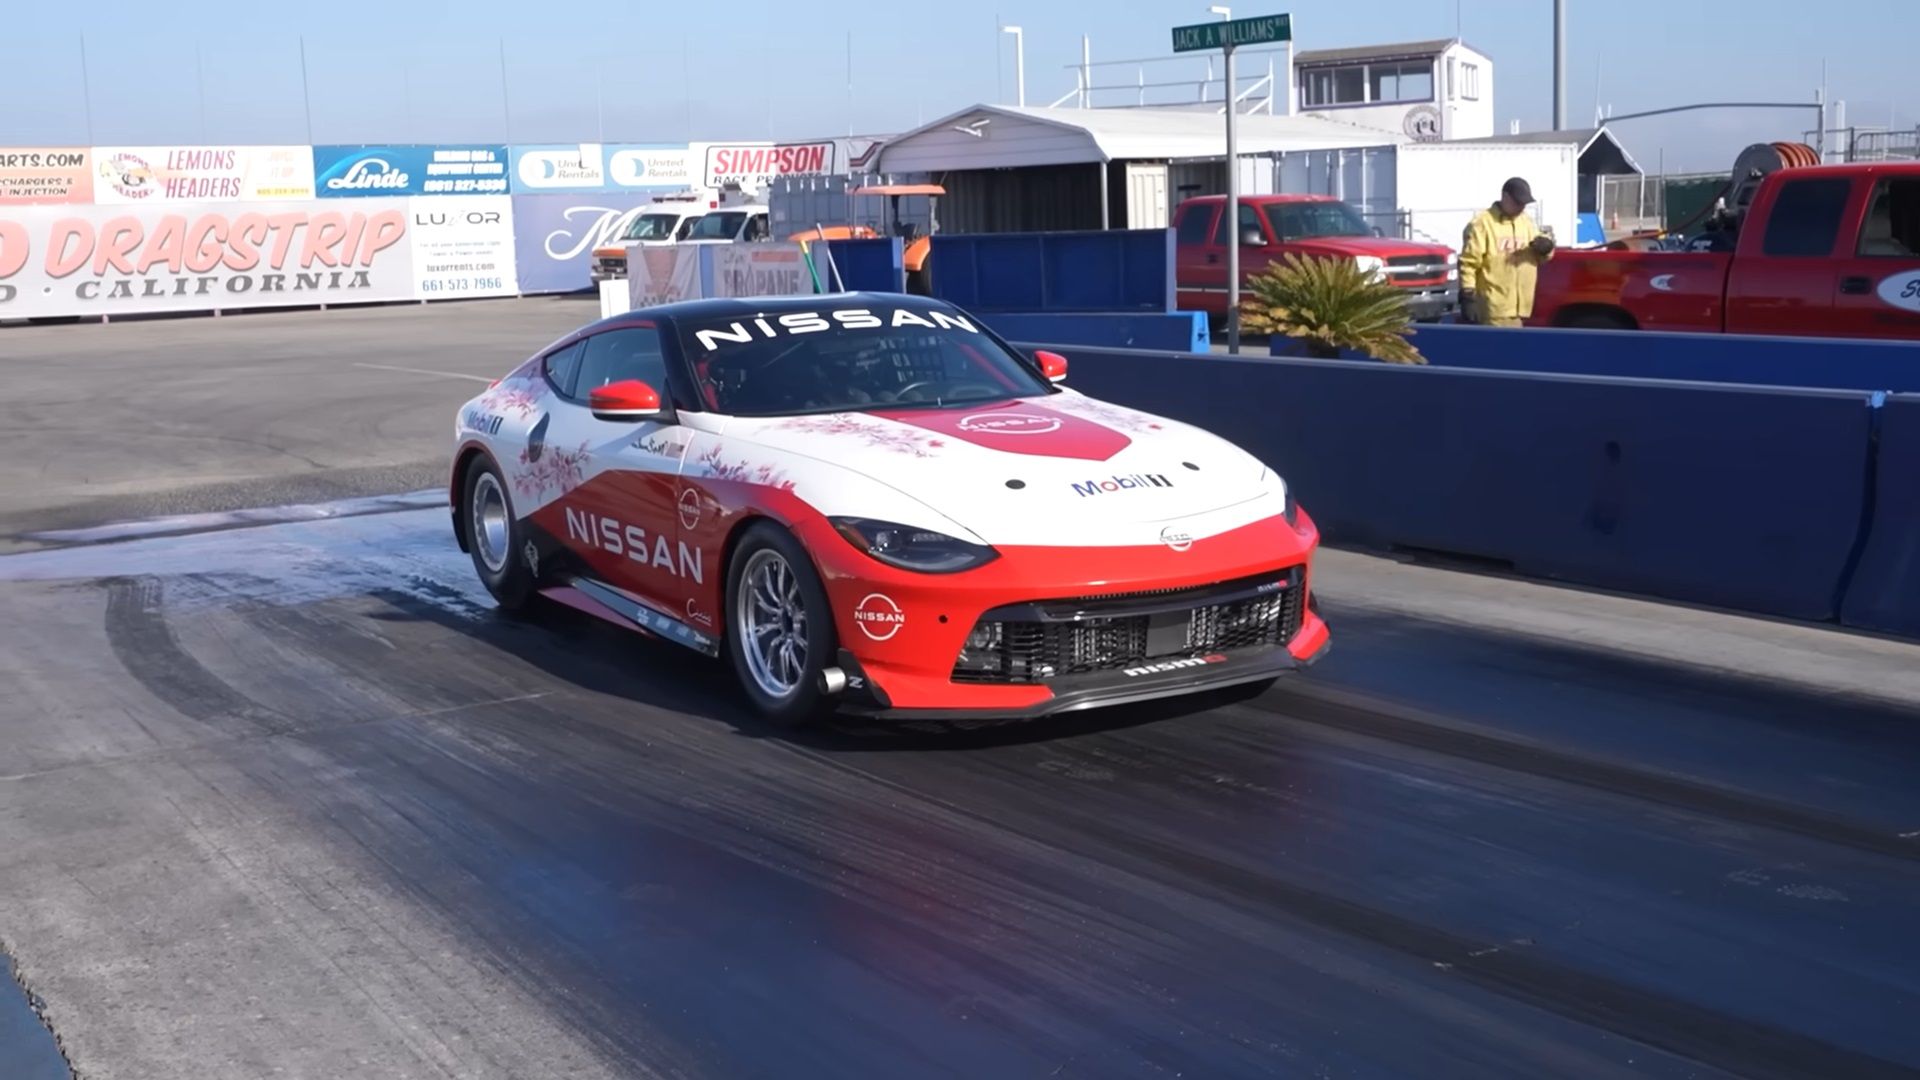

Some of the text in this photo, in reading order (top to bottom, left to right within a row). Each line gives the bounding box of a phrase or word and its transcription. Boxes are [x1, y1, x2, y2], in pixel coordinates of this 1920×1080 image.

[1174, 28, 1201, 49] JACK
[1206, 27, 1214, 45] A
[1218, 20, 1276, 44] WILLIAMS
[166, 150, 235, 171] LEMONS
[647, 158, 684, 168] United
[714, 146, 826, 174] SIMPSON
[0, 177, 62, 186] CHARGERS
[328, 158, 409, 190] Linde
[558, 169, 600, 179] Rentals
[647, 168, 687, 178] Rentals
[9, 187, 67, 196] INJECTION
[165, 177, 241, 199] HEADERS
[45, 210, 406, 279] DRAGSTRIP
[75, 271, 371, 302] CALIFORNIA
[723, 269, 799, 296] PROPANE
[1071, 473, 1150, 498] Mobil
[565, 506, 703, 585] NISSAN
[854, 610, 905, 623] NISSAN
[848, 676, 863, 688] Z
